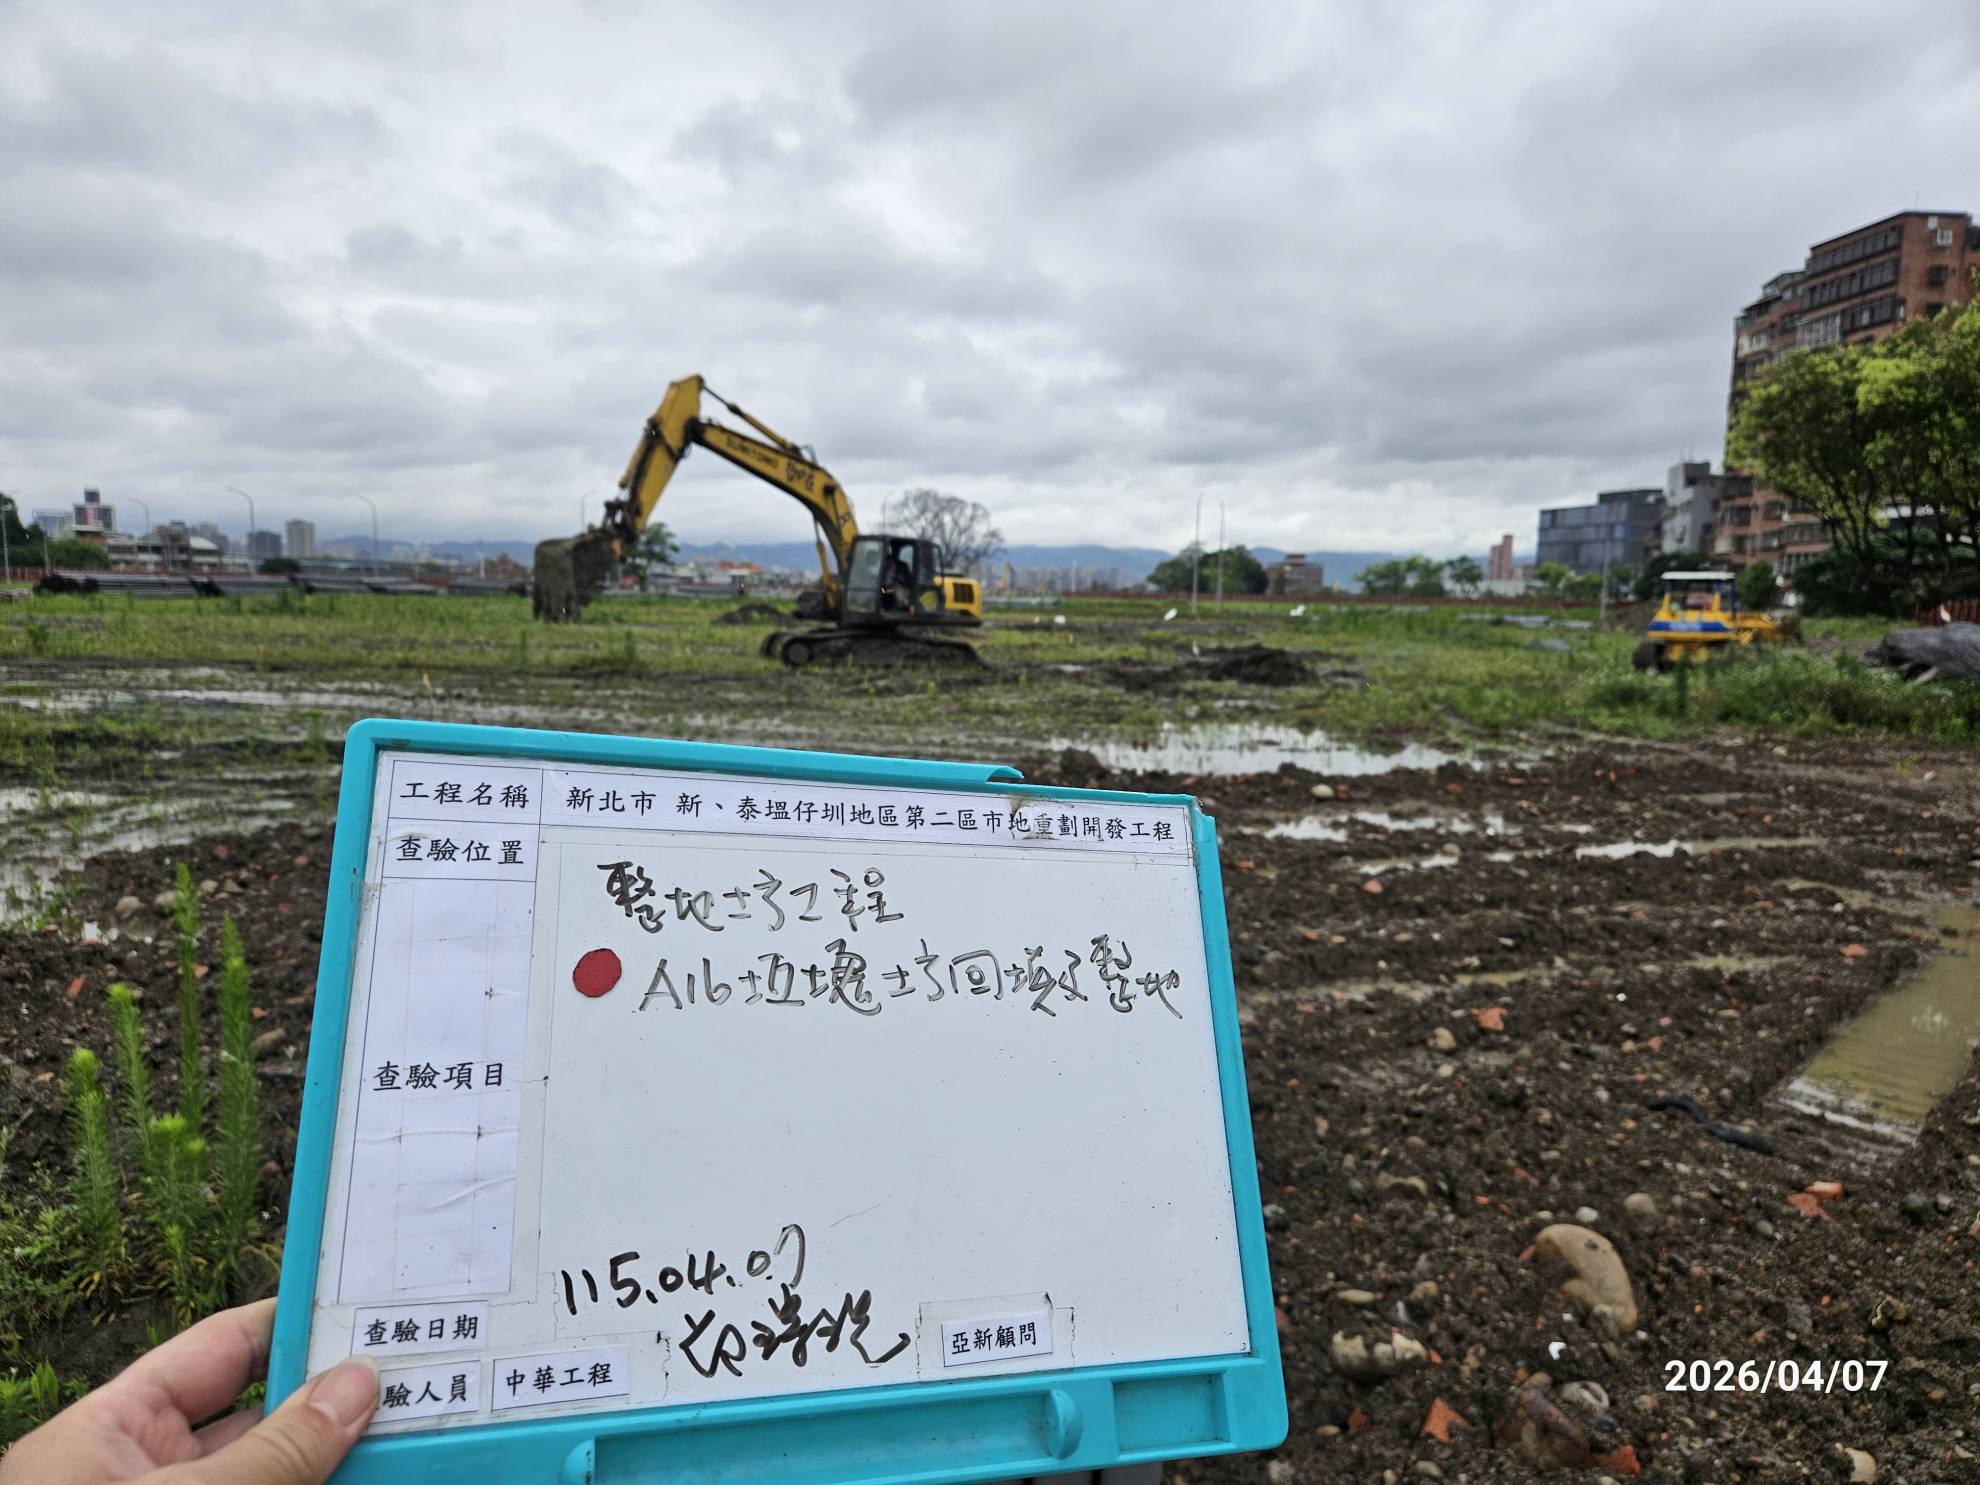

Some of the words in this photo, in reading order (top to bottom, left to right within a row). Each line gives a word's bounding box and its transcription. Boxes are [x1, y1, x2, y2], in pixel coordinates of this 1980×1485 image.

[399, 781, 530, 809] 工程名稱
[566, 786, 657, 816] 新北市
[396, 835, 525, 865] 查驗位置
[373, 1061, 504, 1092] 查驗項目
[364, 1314, 480, 1347] 查驗日期
[951, 1321, 1038, 1354] 亞新顧問
[376, 1374, 467, 1409] 驗人員
[506, 1362, 614, 1397] 中華工程
